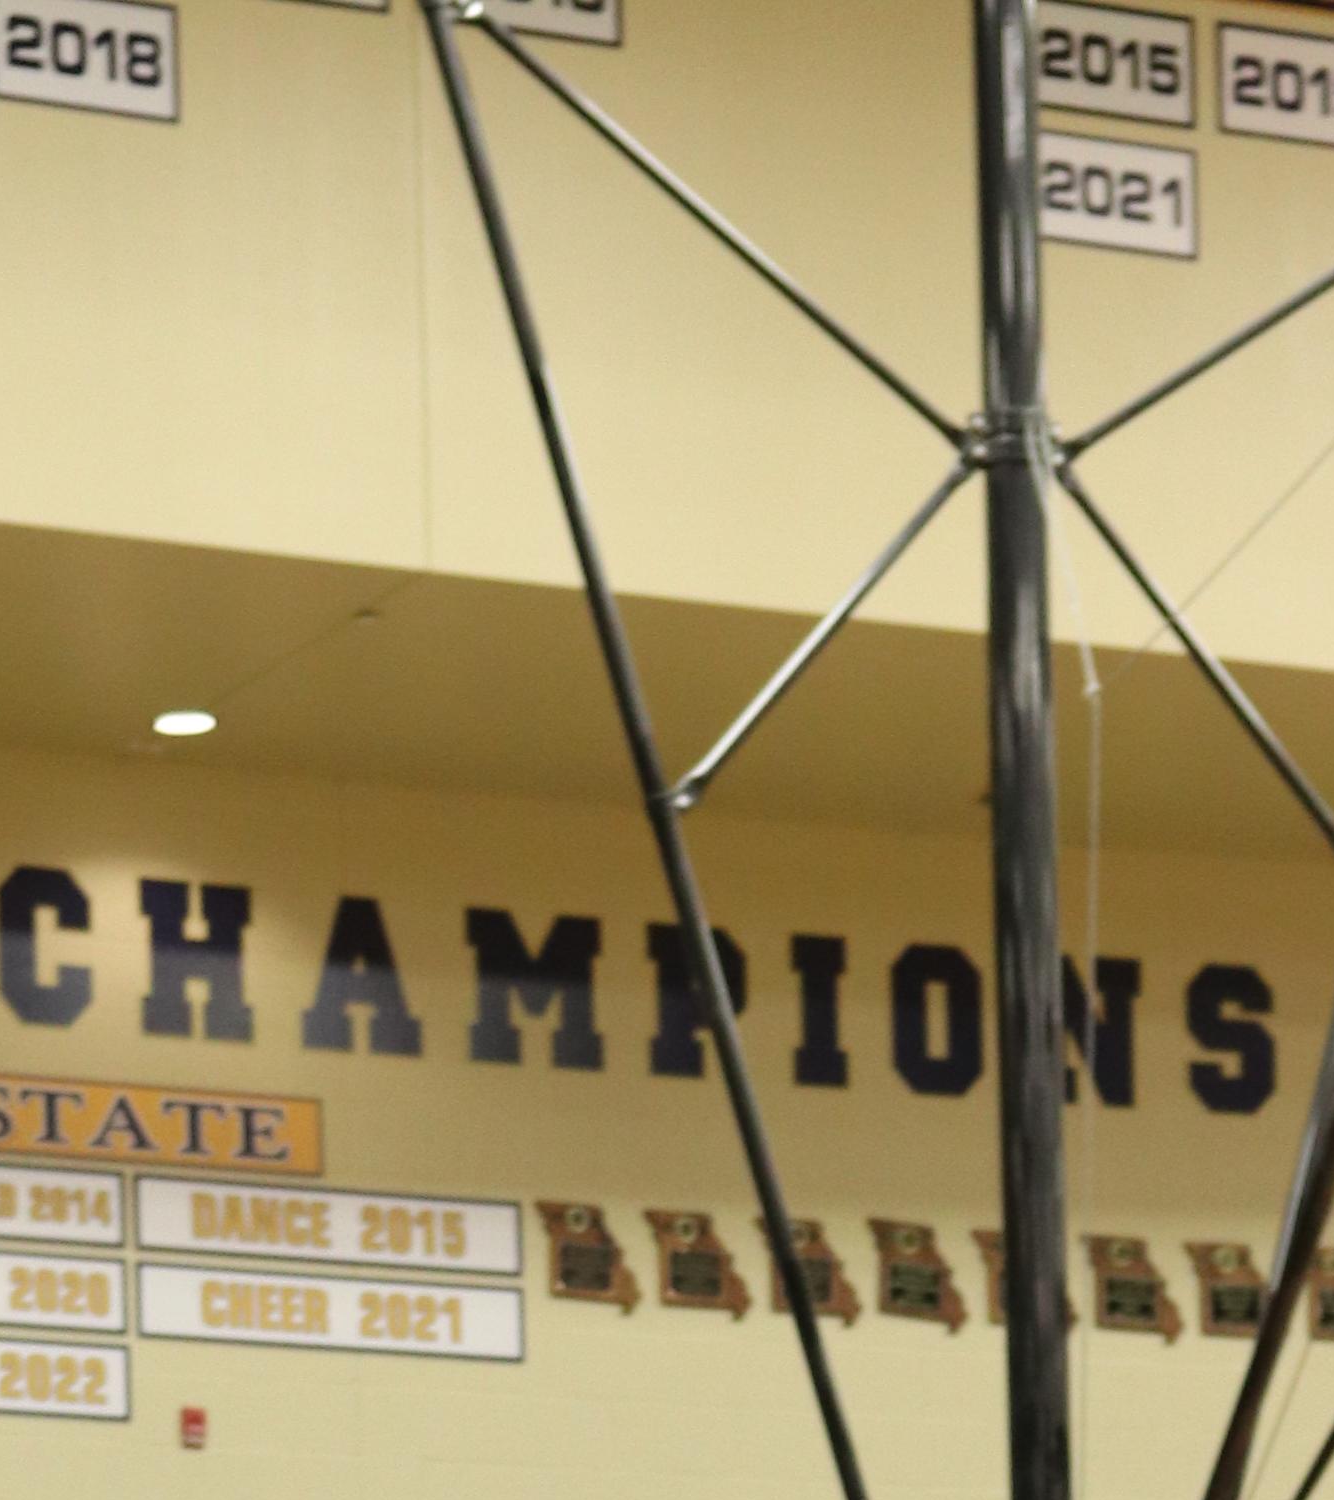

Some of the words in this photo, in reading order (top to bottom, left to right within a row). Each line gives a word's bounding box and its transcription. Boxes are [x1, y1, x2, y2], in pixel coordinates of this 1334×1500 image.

[4, 13, 164, 88] 2018
[1041, 28, 1180, 96] 2015
[1043, 161, 1184, 228] 2021
[28, 1184, 113, 1228] 2014
[189, 1192, 332, 1251] DANCE
[360, 1205, 466, 1259] 2015
[8, 1264, 112, 1318] 2020
[200, 1278, 330, 1336] CHEER
[358, 1292, 465, 1344] 2021
